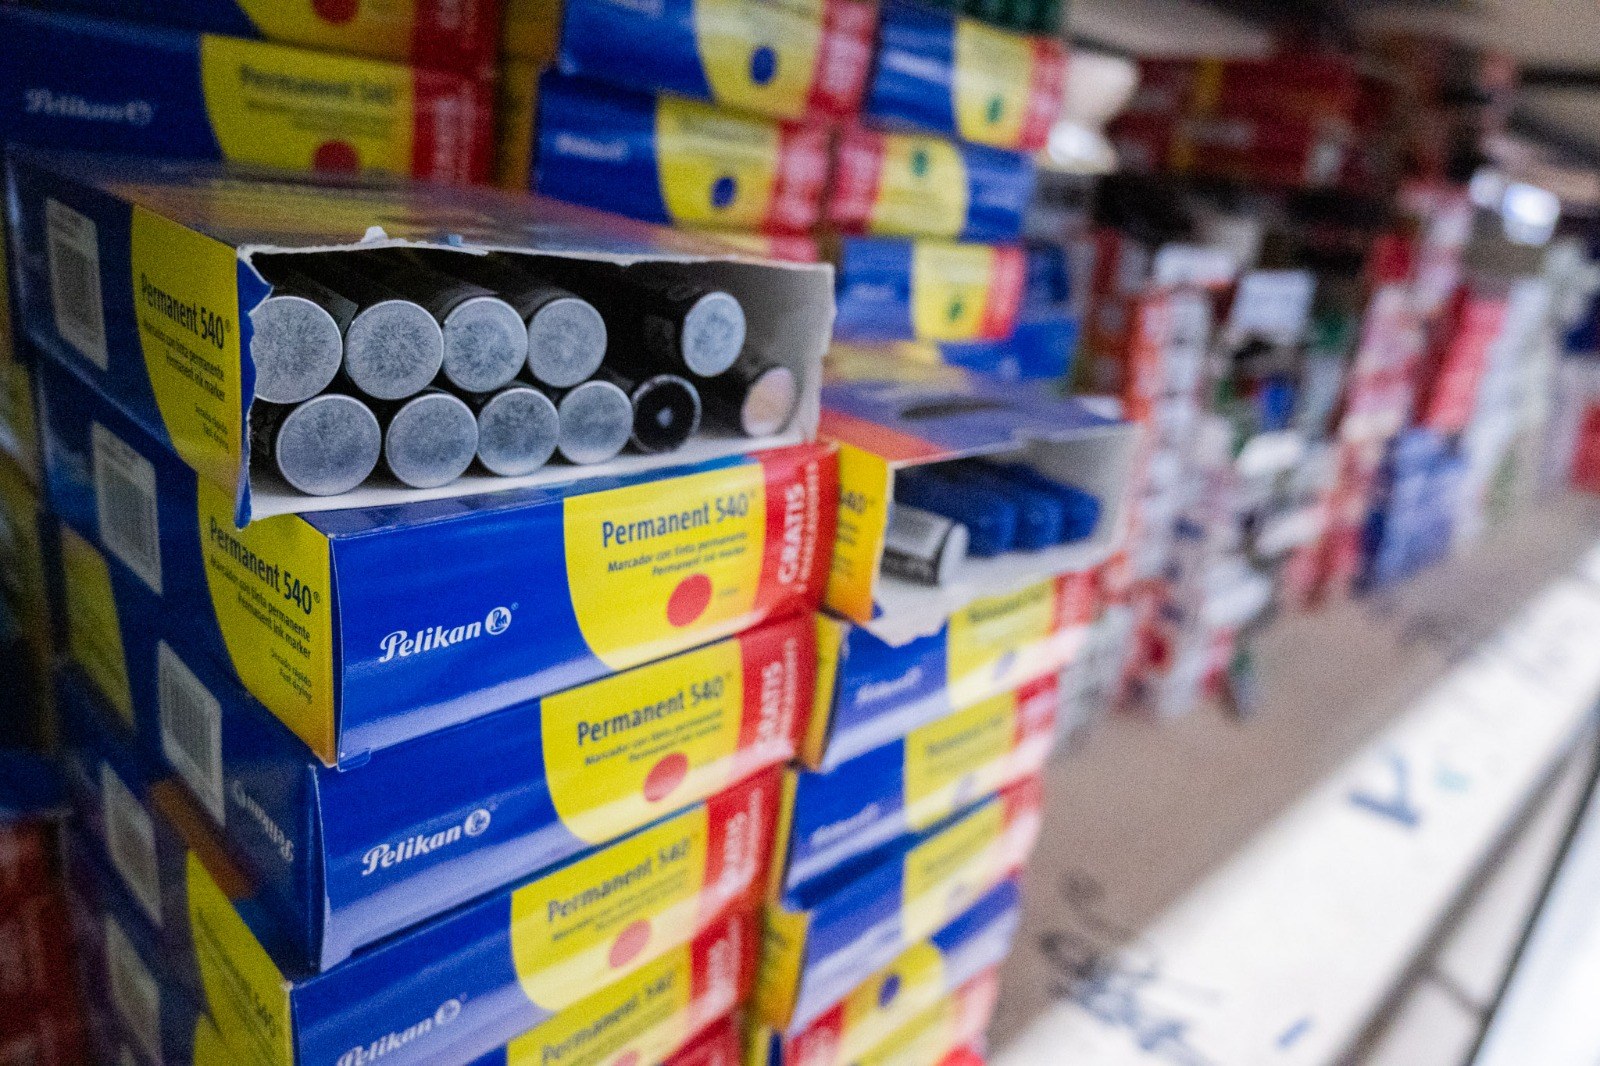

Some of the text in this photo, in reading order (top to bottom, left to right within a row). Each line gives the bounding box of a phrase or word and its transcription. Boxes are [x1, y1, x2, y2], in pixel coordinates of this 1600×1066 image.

[140, 272, 198, 335] Permanent
[602, 502, 711, 548] Permanent
[776, 483, 806, 584] GRATIS
[209, 515, 281, 594] Permanent
[607, 551, 654, 573] Marcador
[268, 600, 311, 643] permanente
[273, 617, 285, 640] ink
[285, 630, 312, 660] marker
[378, 620, 482, 663] Pelikan
[577, 689, 685, 747] Permanent
[361, 824, 462, 876] Pelikan
[334, 1016, 434, 1066] Pelikan
